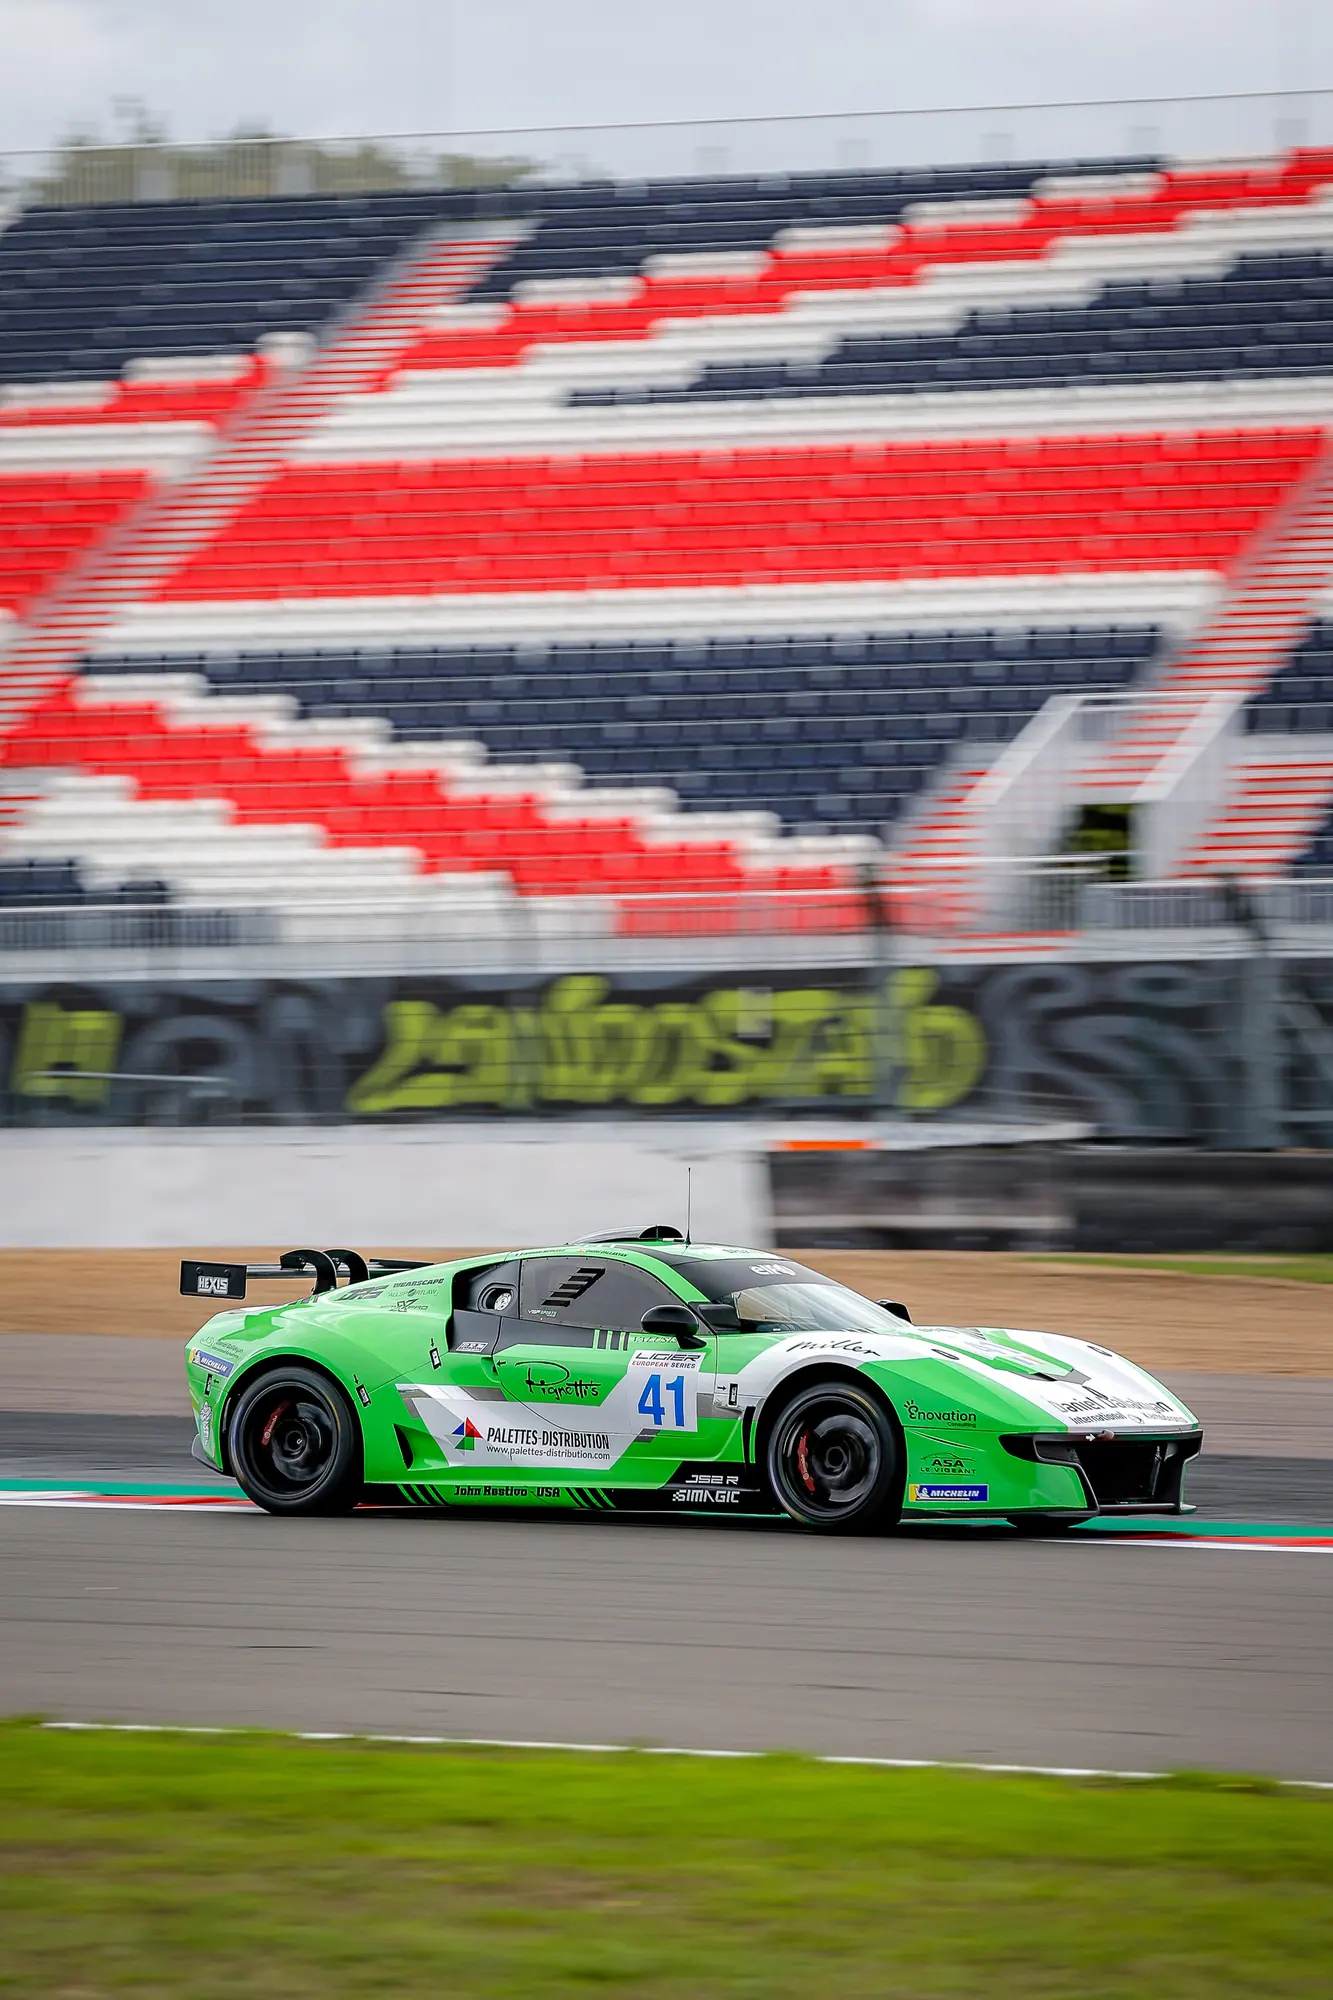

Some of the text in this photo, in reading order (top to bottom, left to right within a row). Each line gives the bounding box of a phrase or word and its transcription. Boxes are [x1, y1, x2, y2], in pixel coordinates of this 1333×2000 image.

[197, 1276, 229, 1295] HEXIS
[200, 1356, 228, 1372] MICHELIN
[635, 1353, 701, 1362] LIGIER
[637, 1374, 685, 1427] 41
[1069, 1411, 1127, 1424] International
[487, 1427, 609, 1449] PALETTES-DISTRIBUTION
[487, 1445, 610, 1460] www.palettes-distribution.com
[932, 1459, 964, 1467] ASA
[726, 1475, 739, 1485] R
[454, 1485, 481, 1496] John
[537, 1487, 560, 1497] USA
[673, 1489, 740, 1503] SIMAGIC
